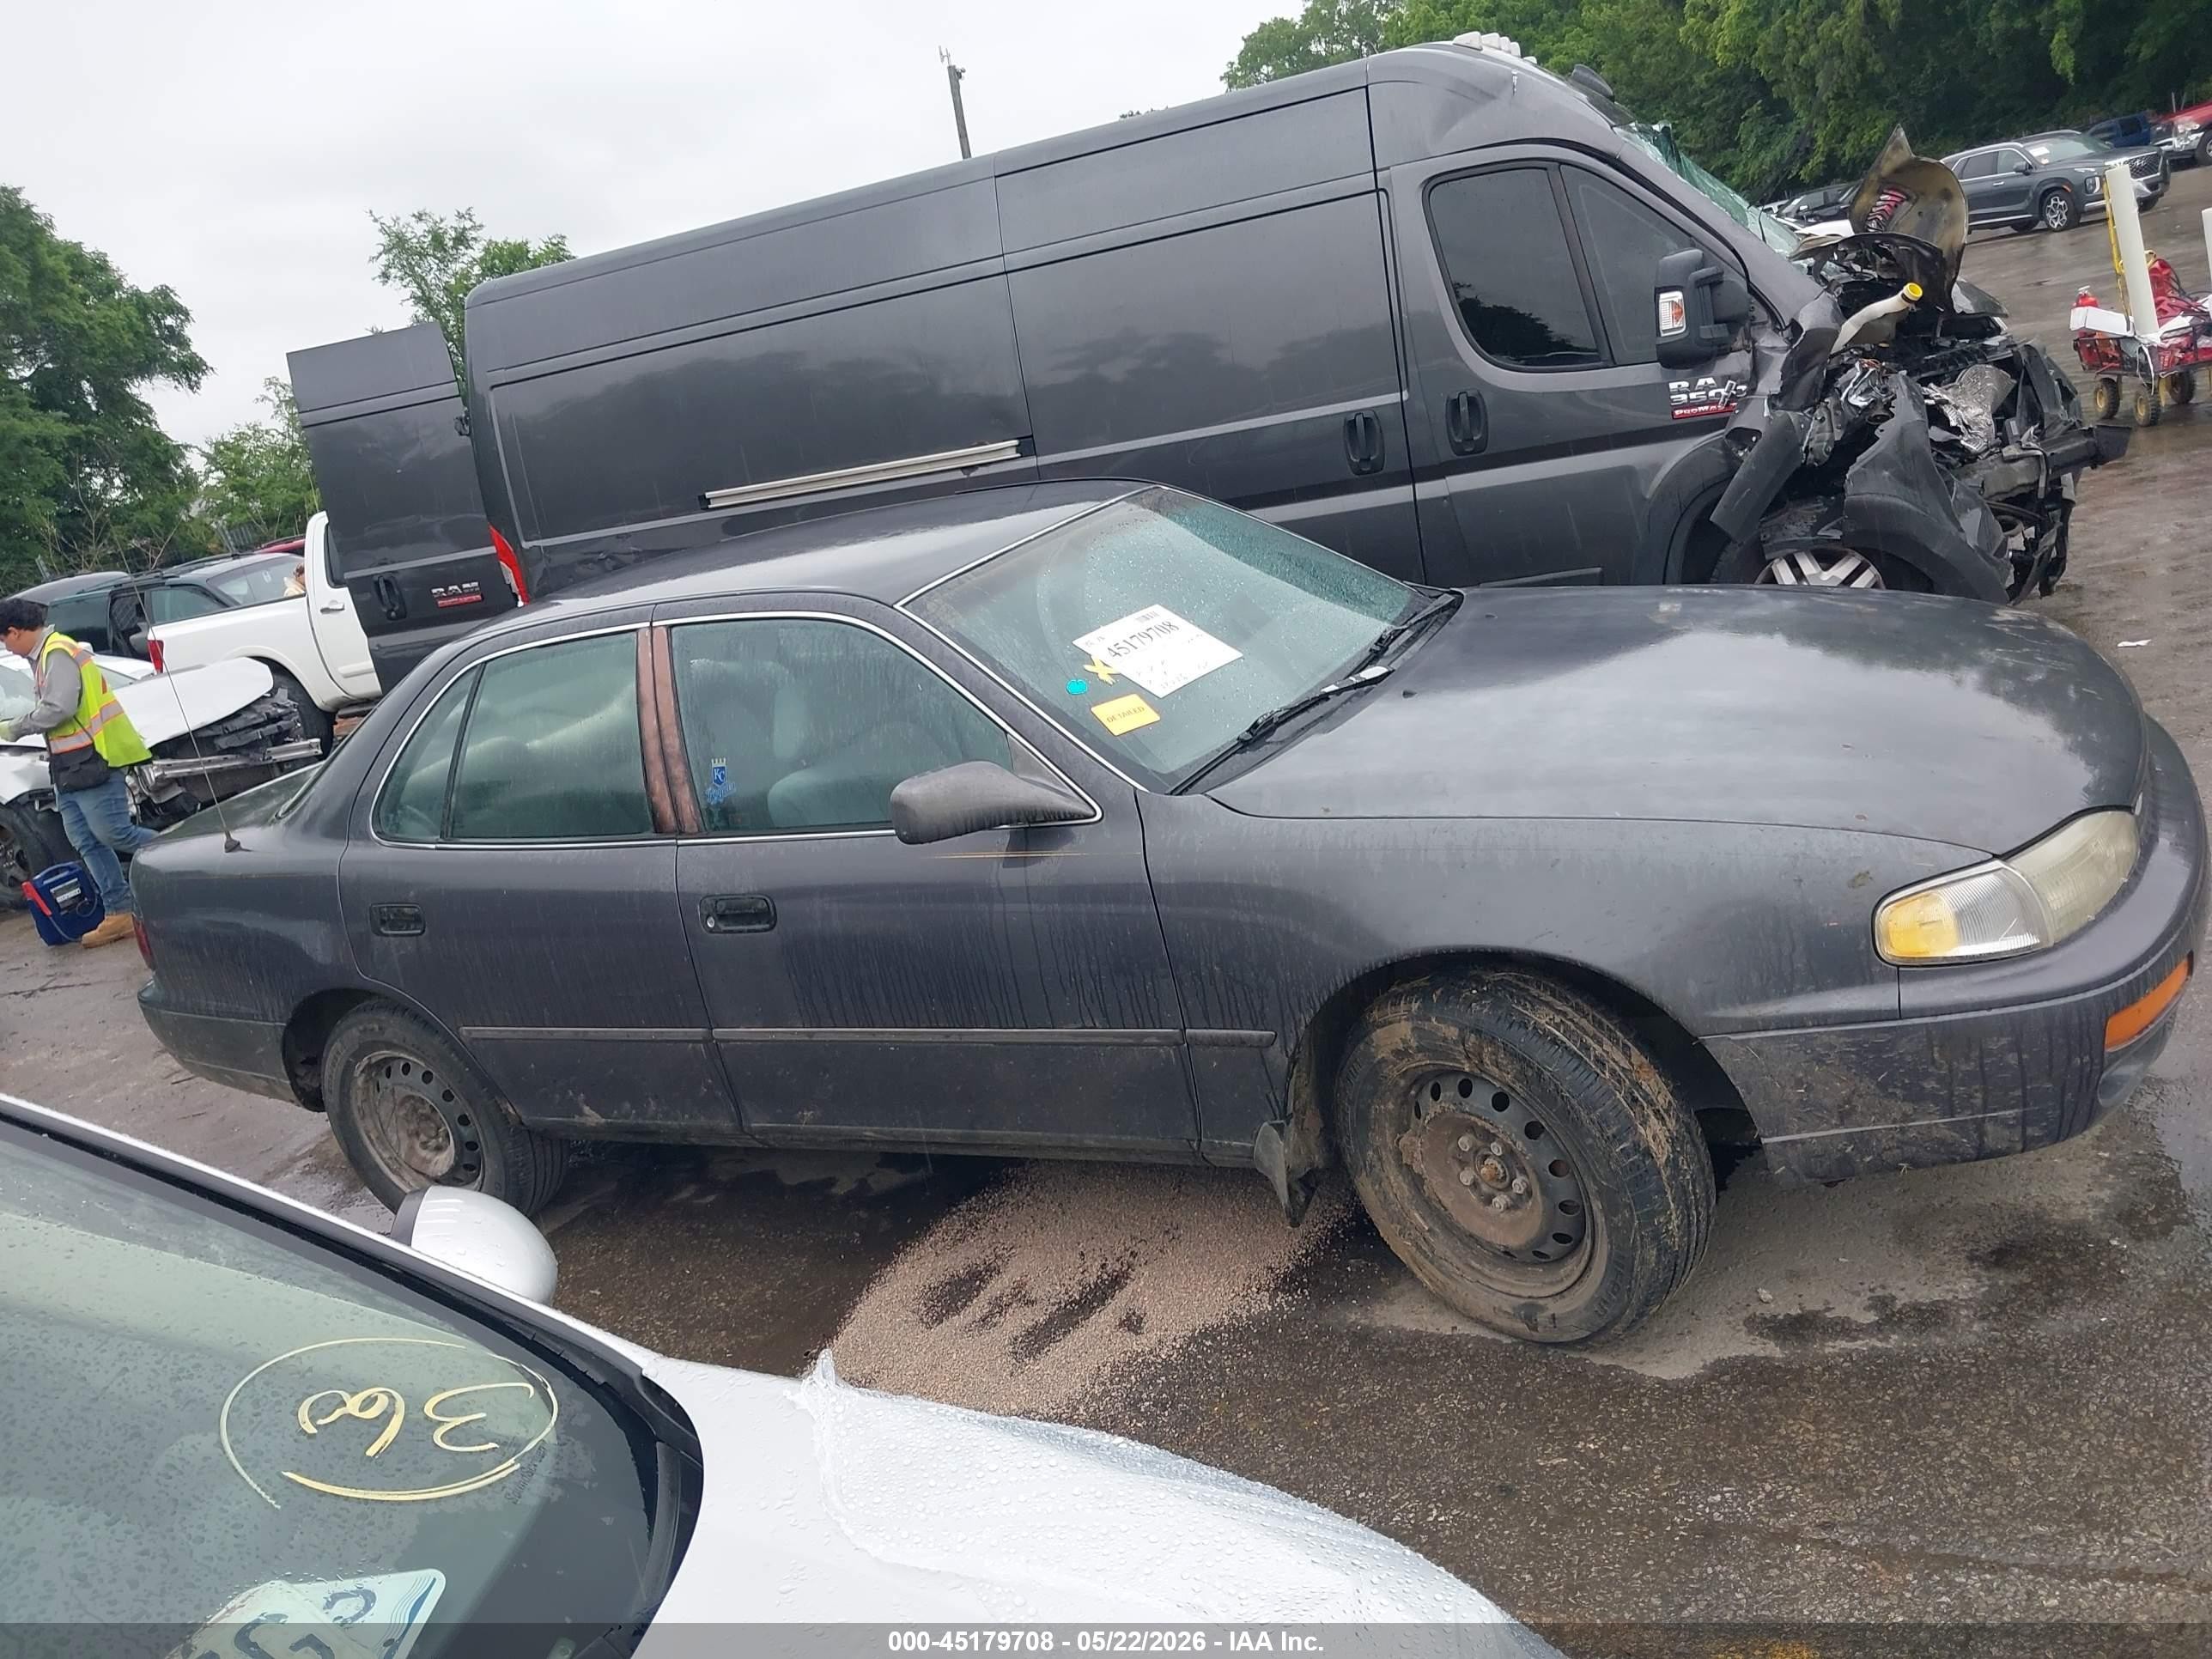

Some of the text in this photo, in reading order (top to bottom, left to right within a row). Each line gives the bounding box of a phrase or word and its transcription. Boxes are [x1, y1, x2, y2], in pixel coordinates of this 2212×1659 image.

[431, 581, 480, 598] RAM
[1107, 620, 1180, 659] 45179708
[1106, 705, 1146, 724] DETAILED
[714, 768, 726, 782] KC
